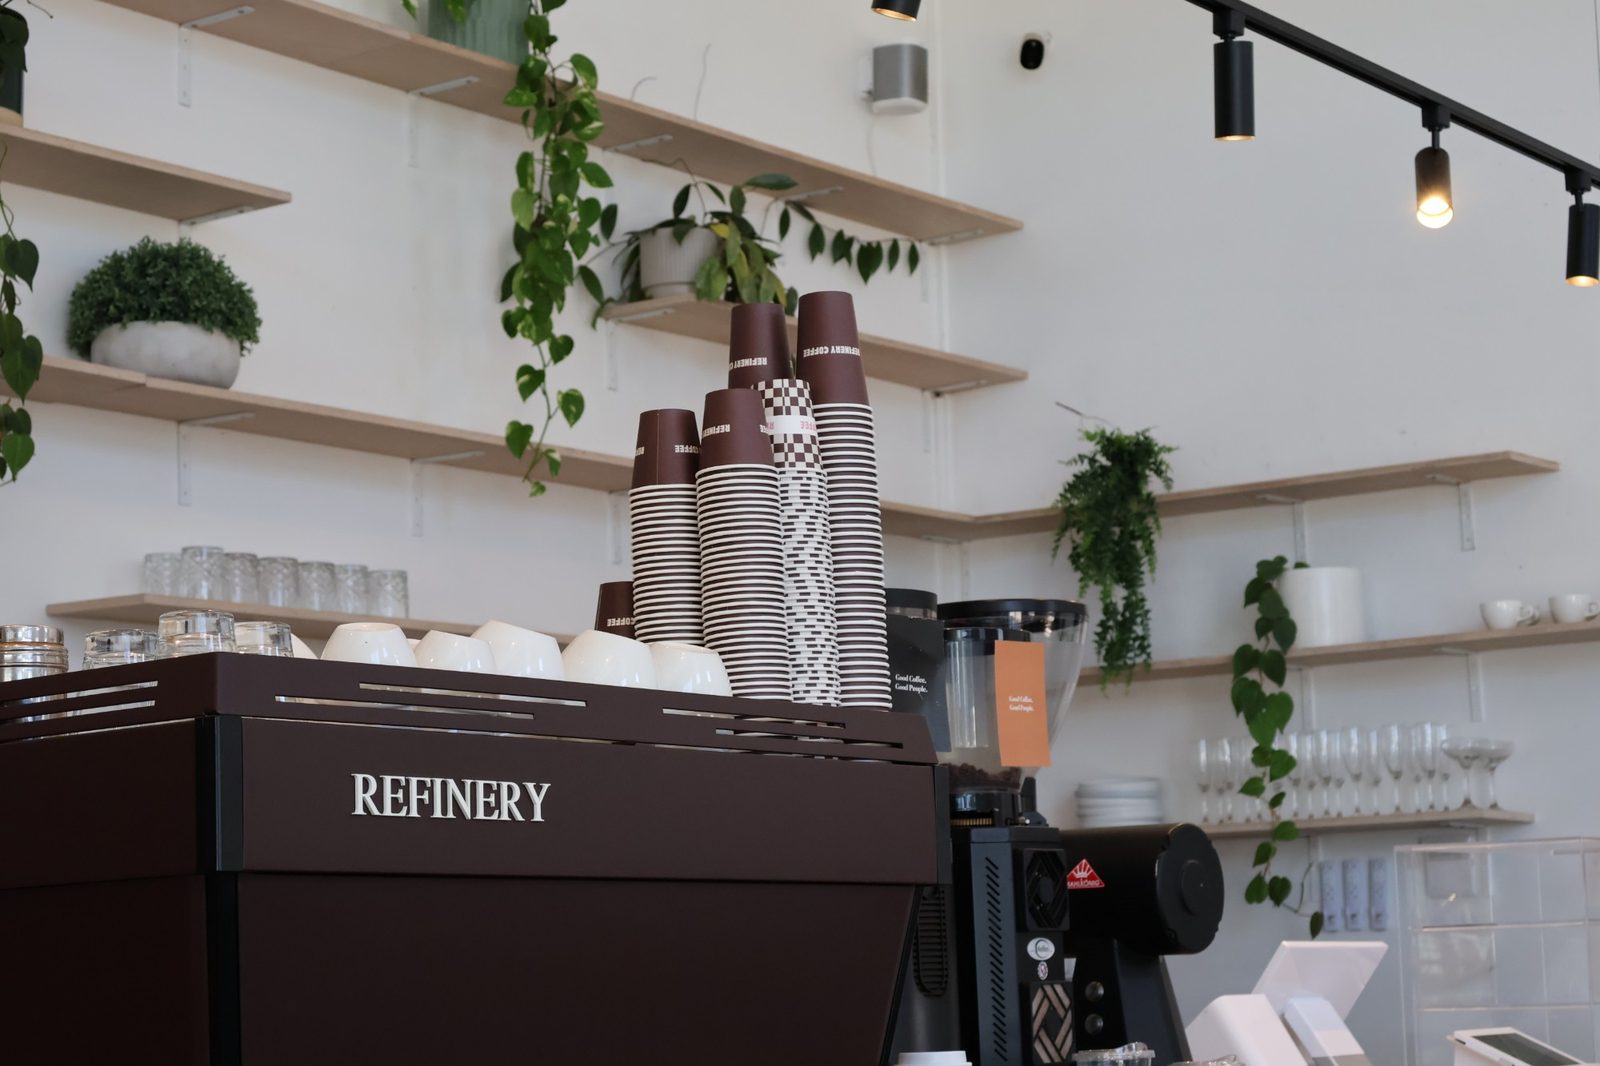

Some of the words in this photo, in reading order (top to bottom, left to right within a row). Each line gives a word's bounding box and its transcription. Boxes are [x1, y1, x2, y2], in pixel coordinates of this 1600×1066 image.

[803, 346, 829, 358] COFFEE
[734, 356, 768, 369] REFINERY
[606, 617, 635, 627] COFFEE
[895, 673, 909, 682] Good
[895, 683, 909, 691] Good
[351, 773, 551, 822] REFINERY
